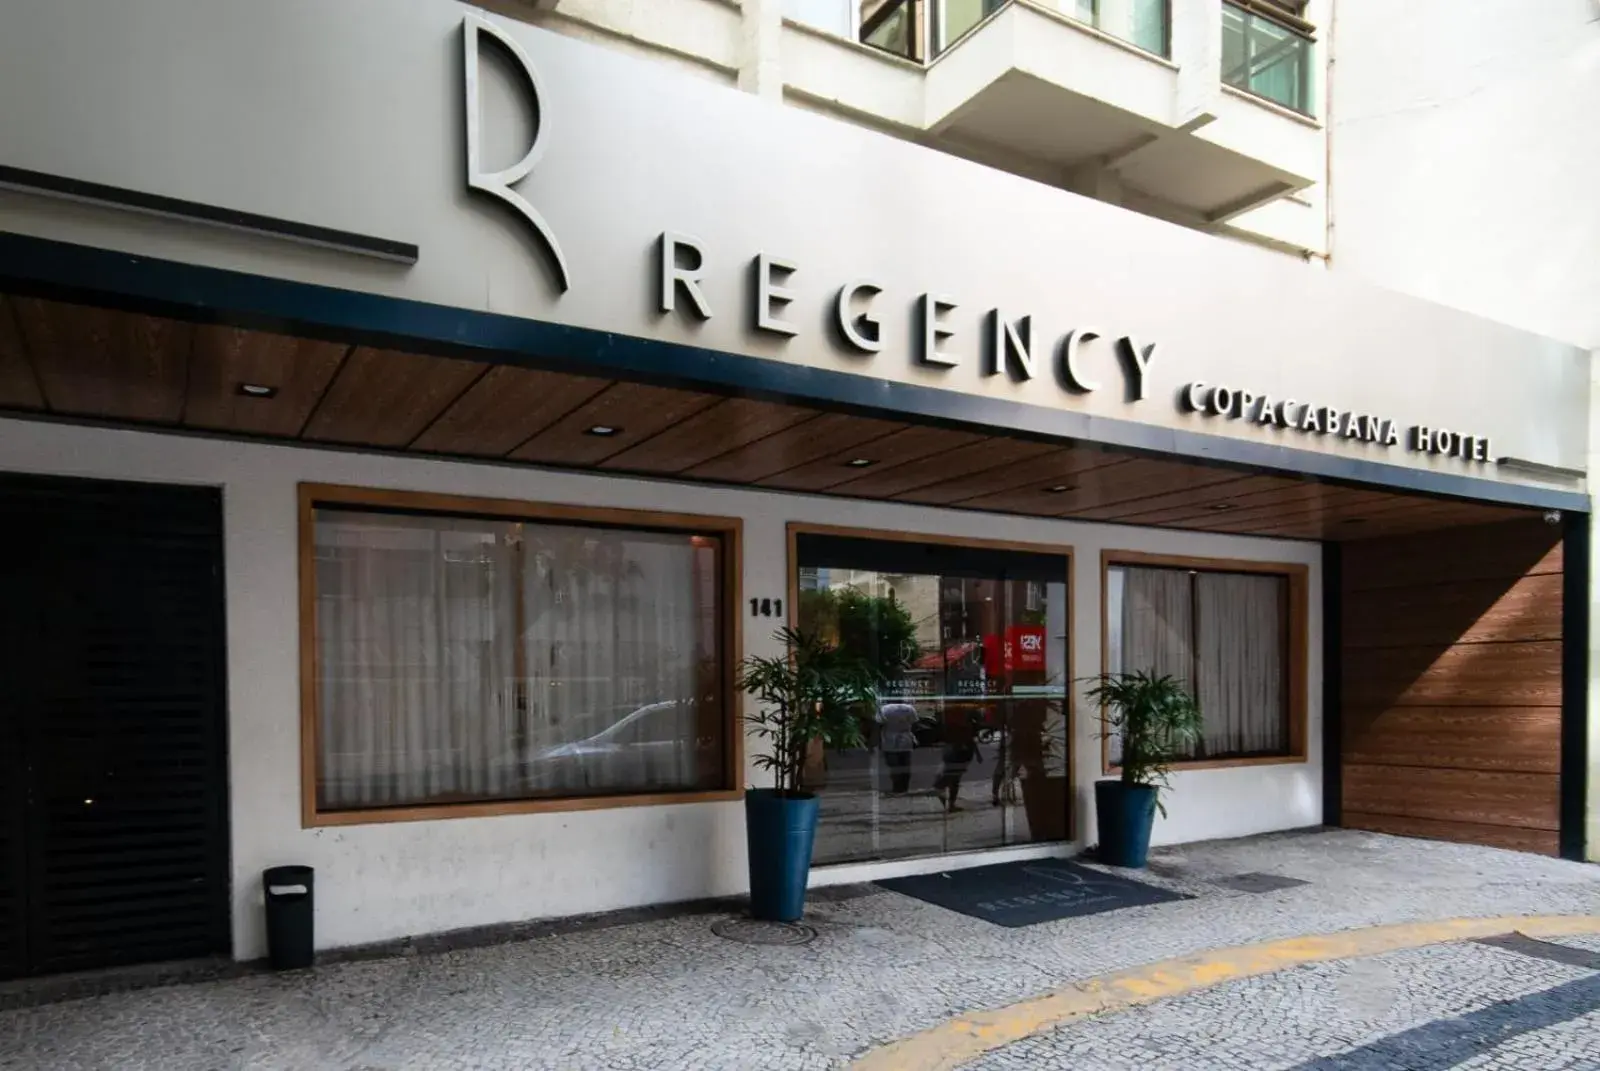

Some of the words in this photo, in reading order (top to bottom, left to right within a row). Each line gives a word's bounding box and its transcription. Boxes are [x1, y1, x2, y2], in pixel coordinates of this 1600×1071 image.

[660, 230, 1157, 400] REGENCY
[1184, 380, 1401, 446] COPACABANA
[1413, 424, 1498, 463] HOTEL
[749, 598, 782, 617] 141
